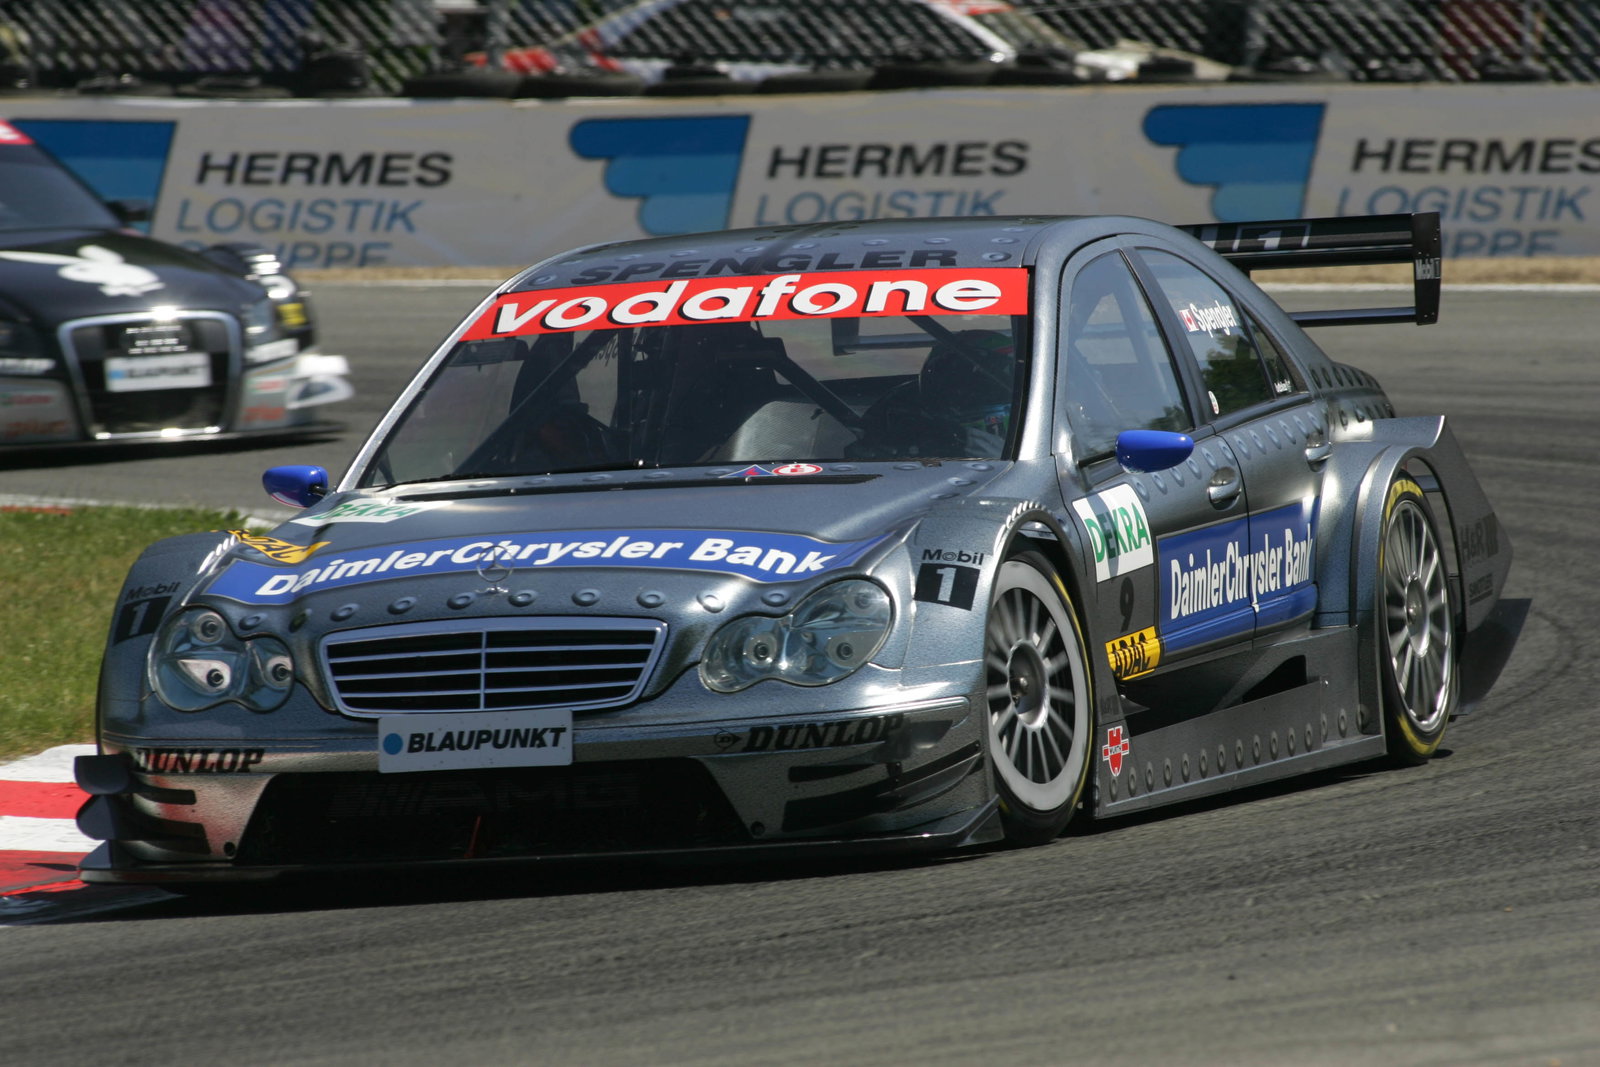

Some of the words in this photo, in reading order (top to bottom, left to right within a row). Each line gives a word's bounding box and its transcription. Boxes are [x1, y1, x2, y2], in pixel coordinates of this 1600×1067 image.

[196, 151, 454, 187] HERMES
[767, 140, 1029, 179] HERMES
[1352, 138, 1600, 174] HERMES
[175, 198, 423, 235] LOGISTIK
[754, 189, 1004, 227] LOGISTIK
[1336, 185, 1592, 222] LOGISTIK
[570, 249, 957, 285] SPENGLER
[496, 274, 1002, 334] vodafone
[1190, 300, 1237, 338] Spengler
[1083, 502, 1151, 563] DEKRA
[255, 535, 681, 597] DaimlerChrysler
[688, 537, 837, 577] Bank
[922, 549, 984, 566] Mobil
[1170, 534, 1283, 620] DaimlerChrysler
[1284, 523, 1314, 587] Bank
[125, 582, 181, 601] Mobil
[936, 567, 956, 602] 1
[128, 601, 150, 637] 1
[1119, 576, 1135, 633] 9
[407, 726, 567, 754] BLAUPUNKT
[743, 711, 904, 752] DUNLOP
[136, 748, 265, 773] DUNLOP
